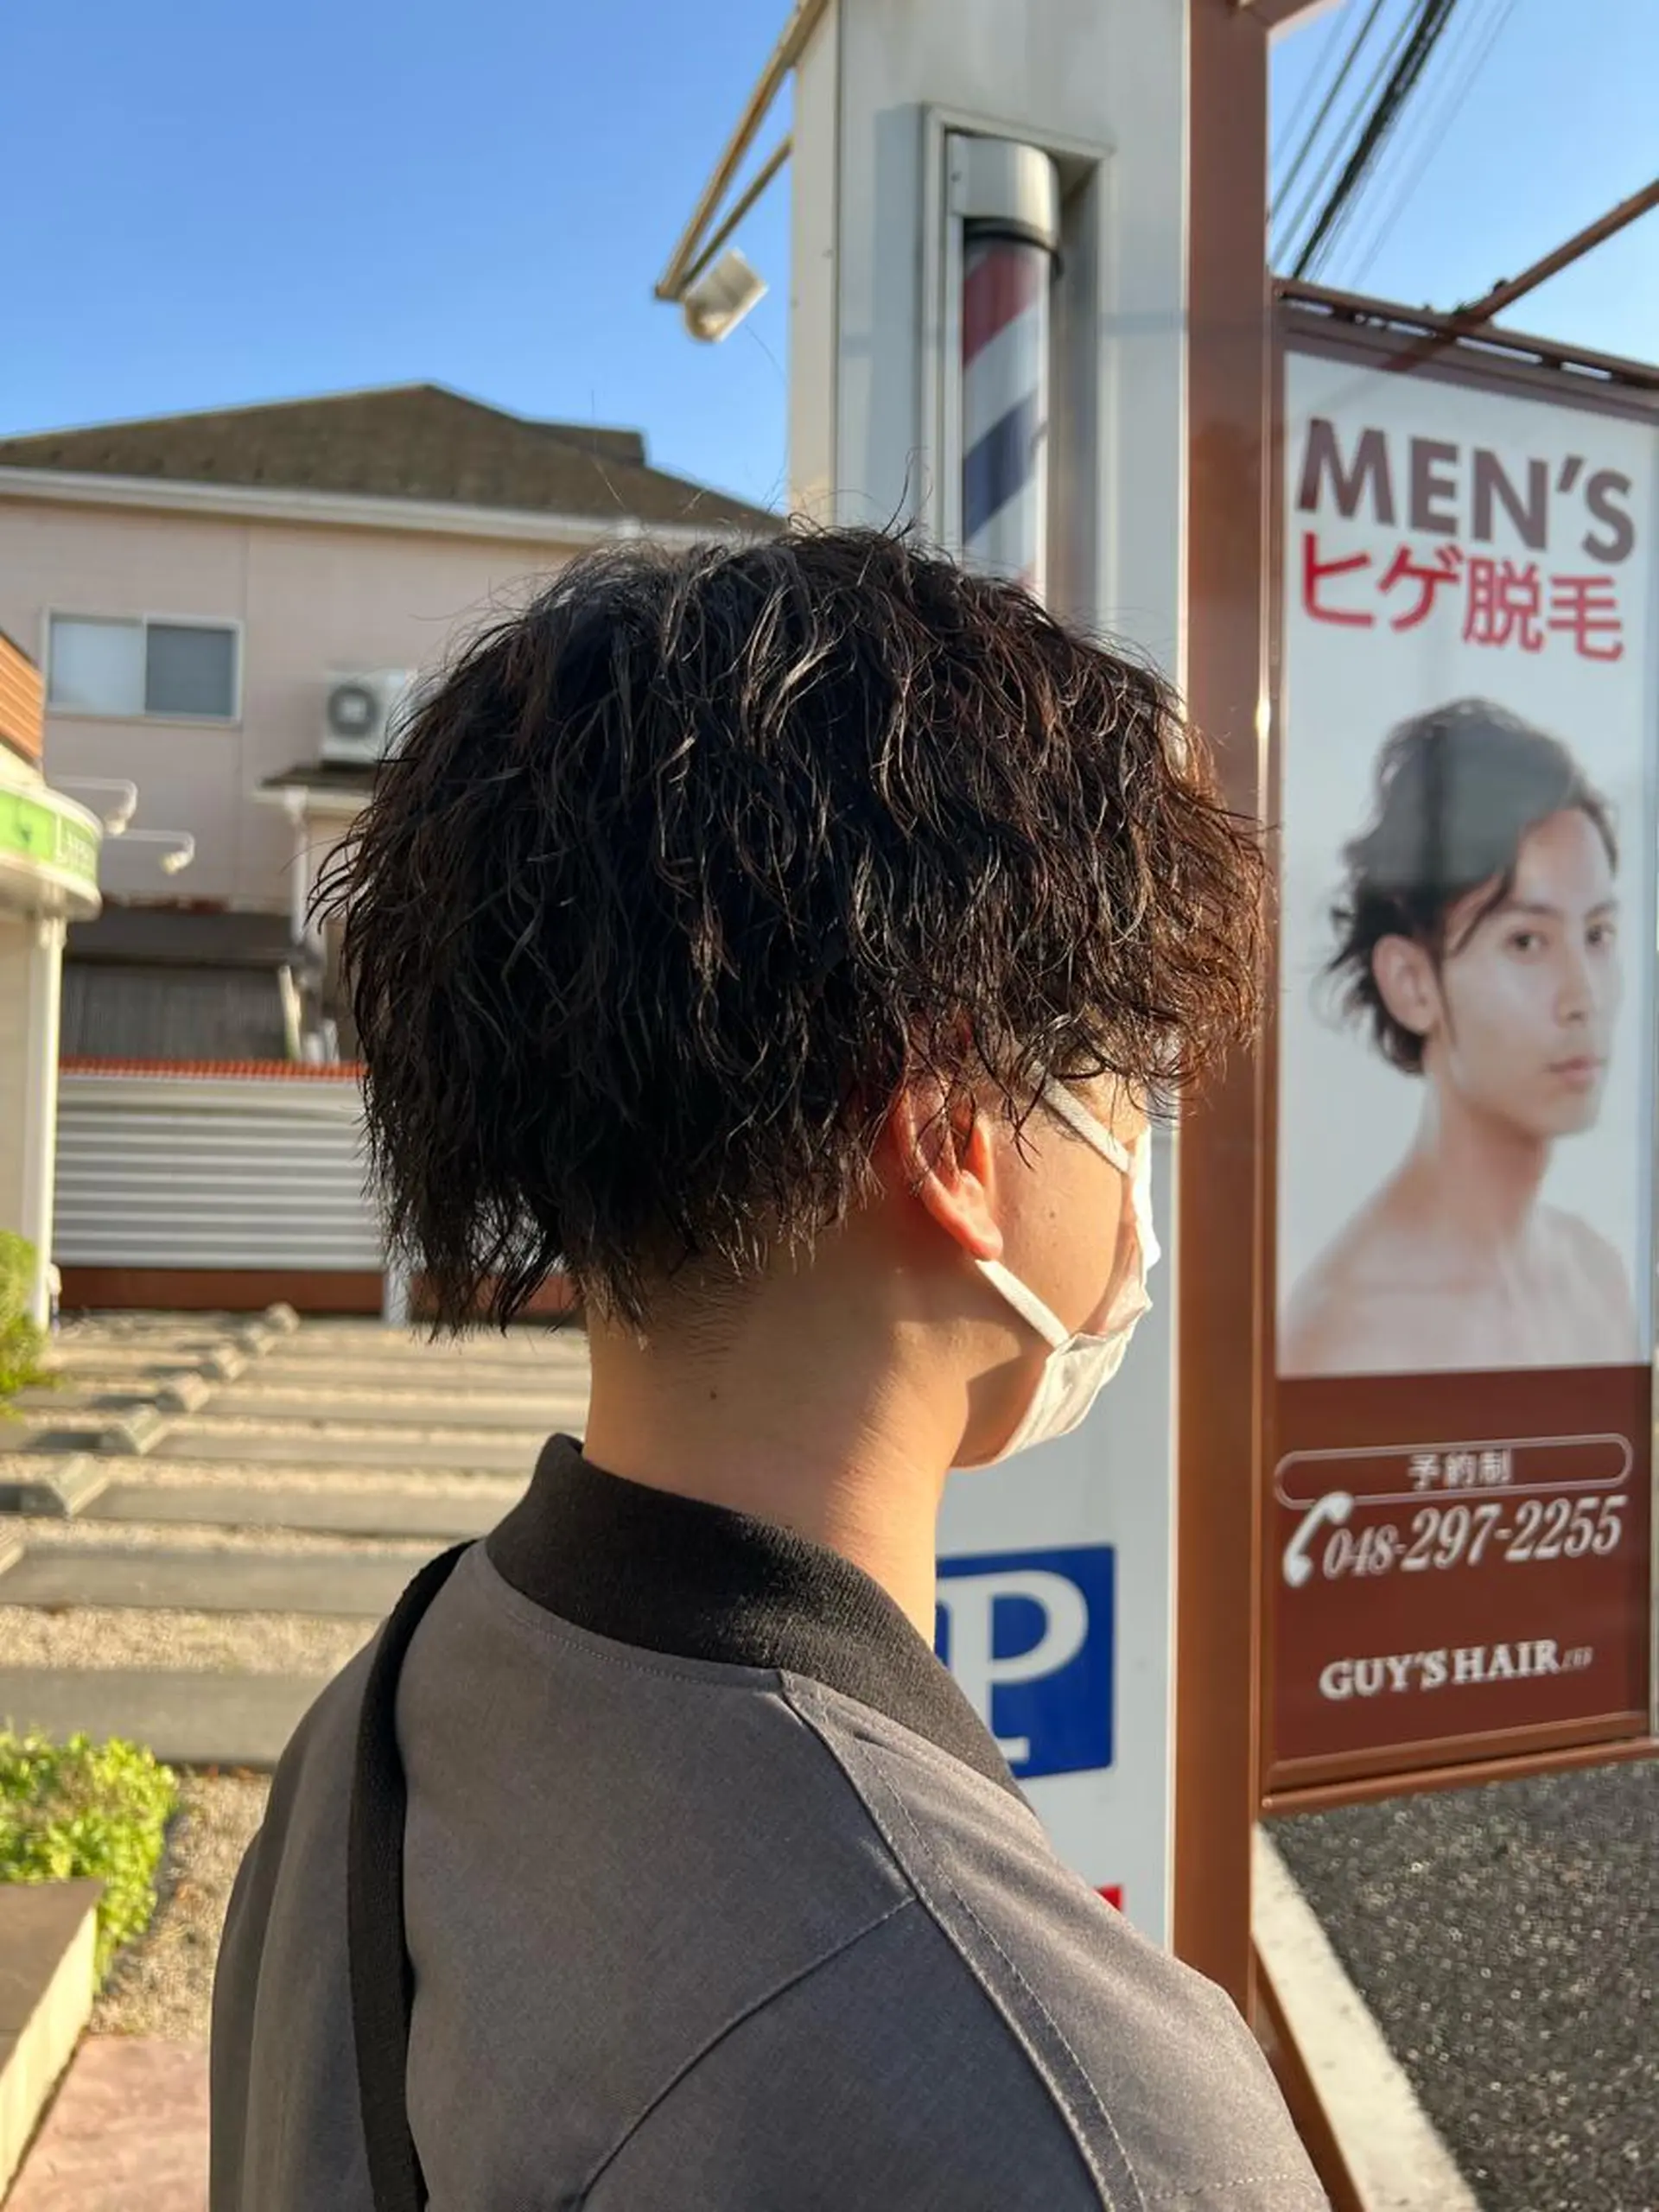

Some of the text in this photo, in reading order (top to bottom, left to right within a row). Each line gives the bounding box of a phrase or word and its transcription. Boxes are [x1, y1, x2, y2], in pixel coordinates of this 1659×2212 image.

[1297, 416, 1636, 564] MEN'S
[1302, 531, 1624, 662] ヒゲ脱毛
[1322, 1496, 1628, 1580] 048-297-2255
[936, 1570, 1089, 1764] P
